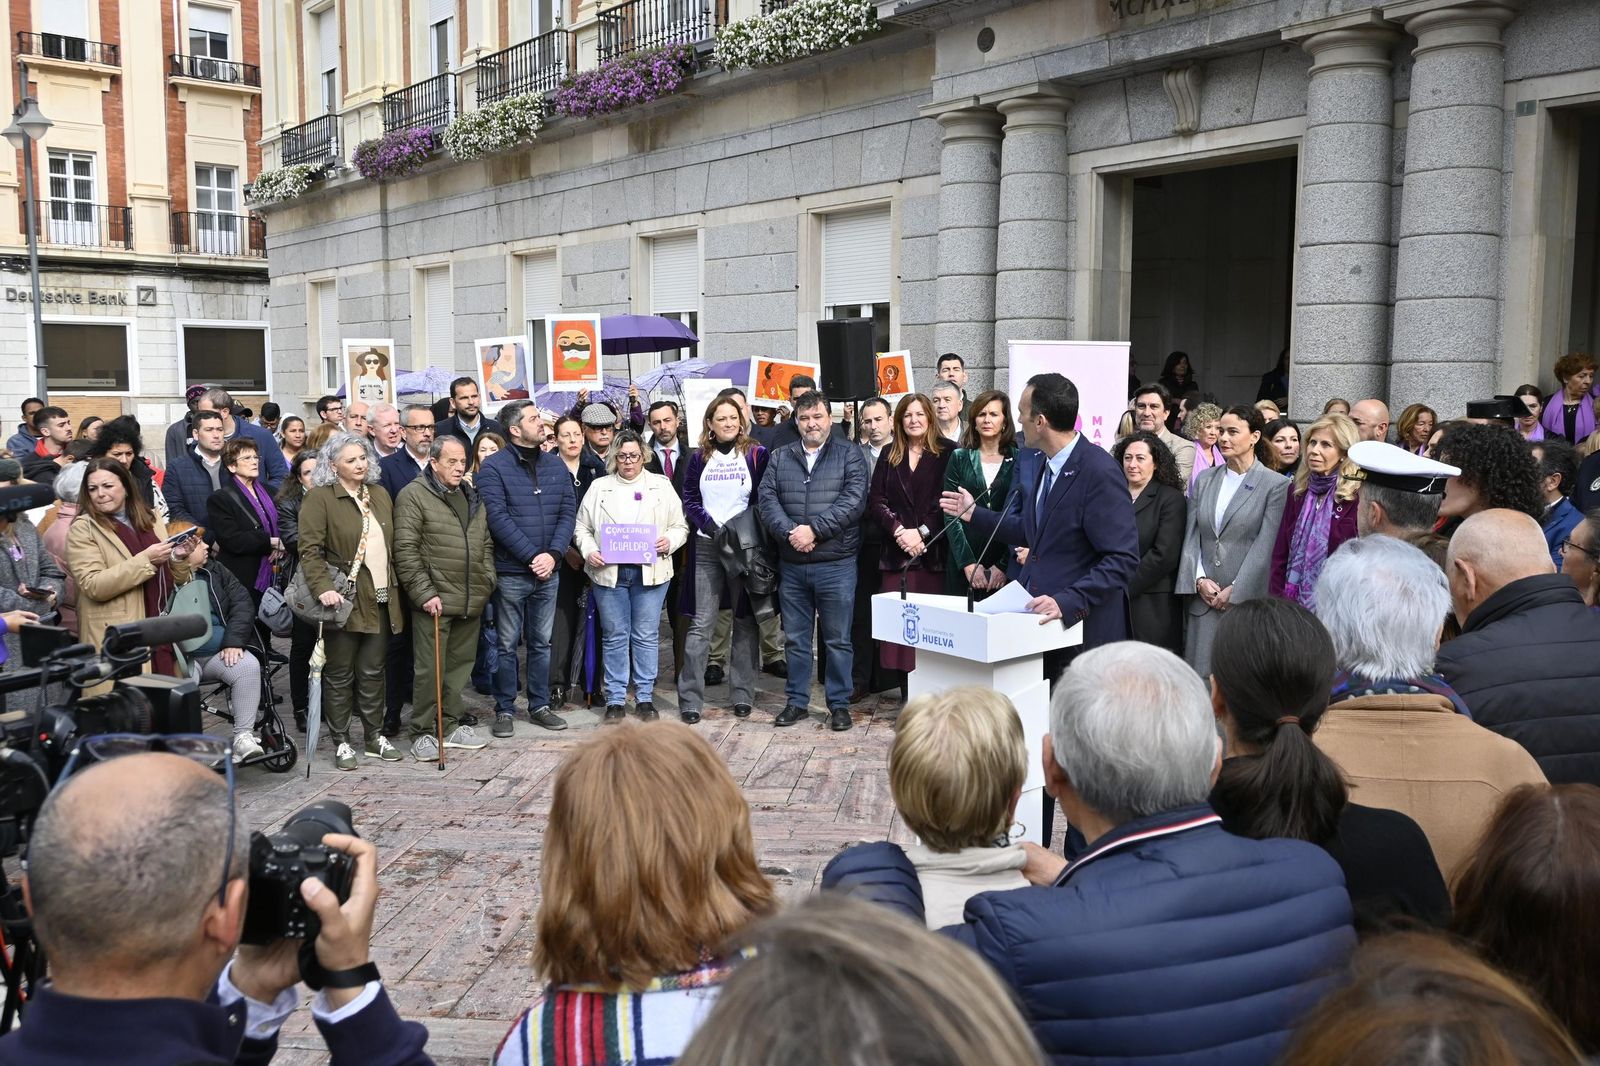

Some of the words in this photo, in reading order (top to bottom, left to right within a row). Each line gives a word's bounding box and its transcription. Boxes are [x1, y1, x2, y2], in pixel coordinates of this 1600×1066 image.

[87, 290, 128, 306] Bank
[705, 473, 747, 482] IGUALDAD
[922, 633, 954, 649] HUELVA
